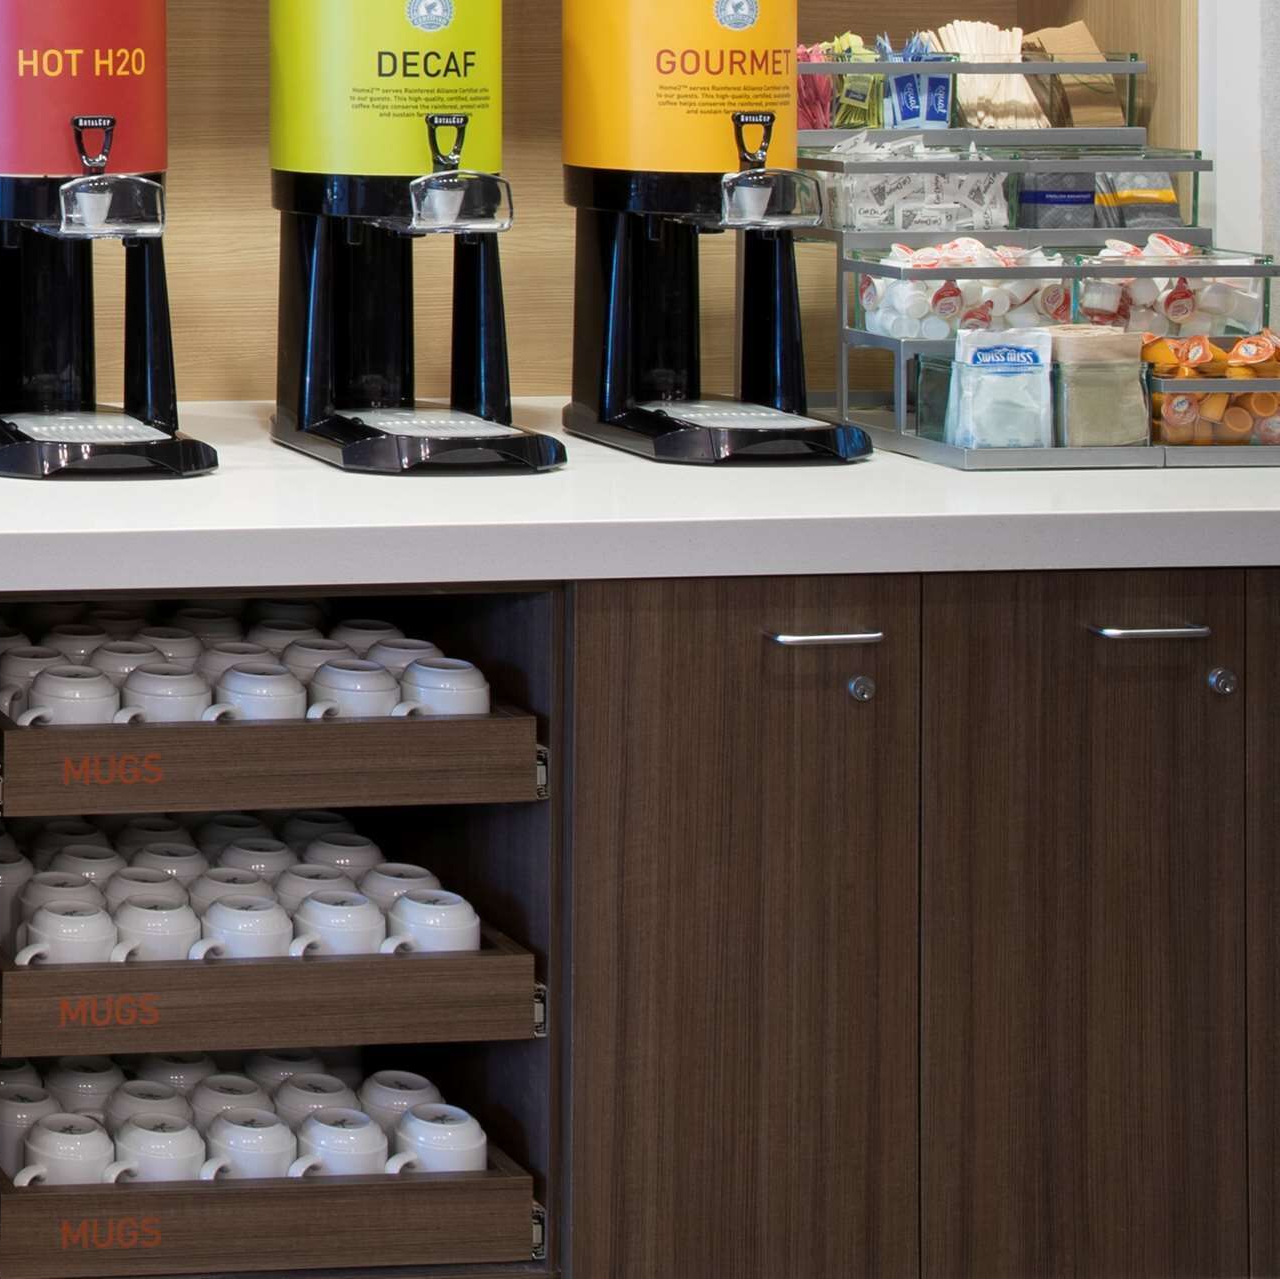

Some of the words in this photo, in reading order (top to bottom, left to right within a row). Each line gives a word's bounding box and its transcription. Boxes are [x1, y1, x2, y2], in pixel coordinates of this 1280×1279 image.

[18, 48, 84, 77] HOT
[377, 51, 476, 78] DECAF
[656, 48, 791, 76] GOURMET
[63, 753, 162, 785] MUGS
[60, 994, 161, 1025] MUGS
[60, 1217, 161, 1249] MUGS
